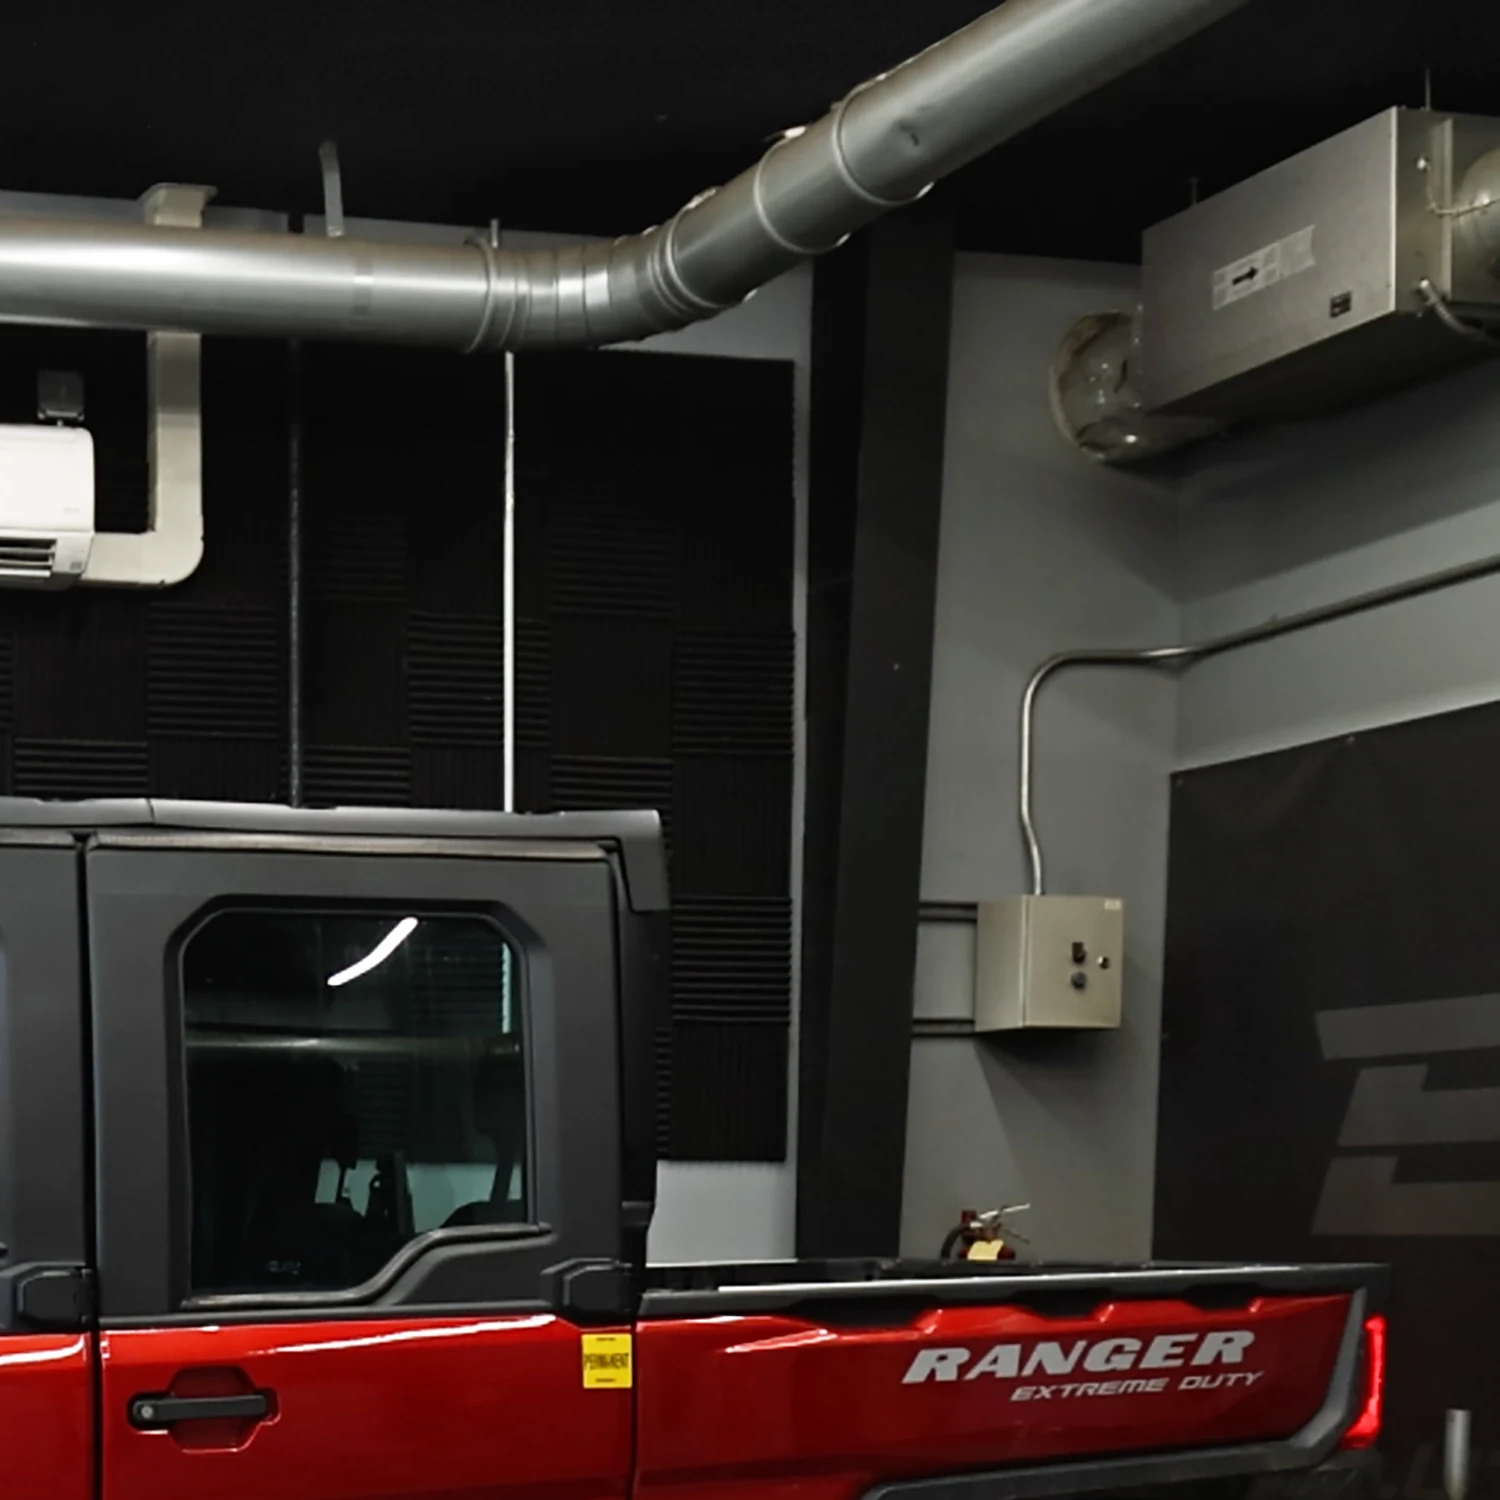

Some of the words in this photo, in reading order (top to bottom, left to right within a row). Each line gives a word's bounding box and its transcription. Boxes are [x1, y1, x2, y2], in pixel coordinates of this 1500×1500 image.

[901, 1330, 1255, 1384] RANGER
[1009, 1377, 1169, 1402] EXTREME
[1177, 1371, 1265, 1391] DUTY
